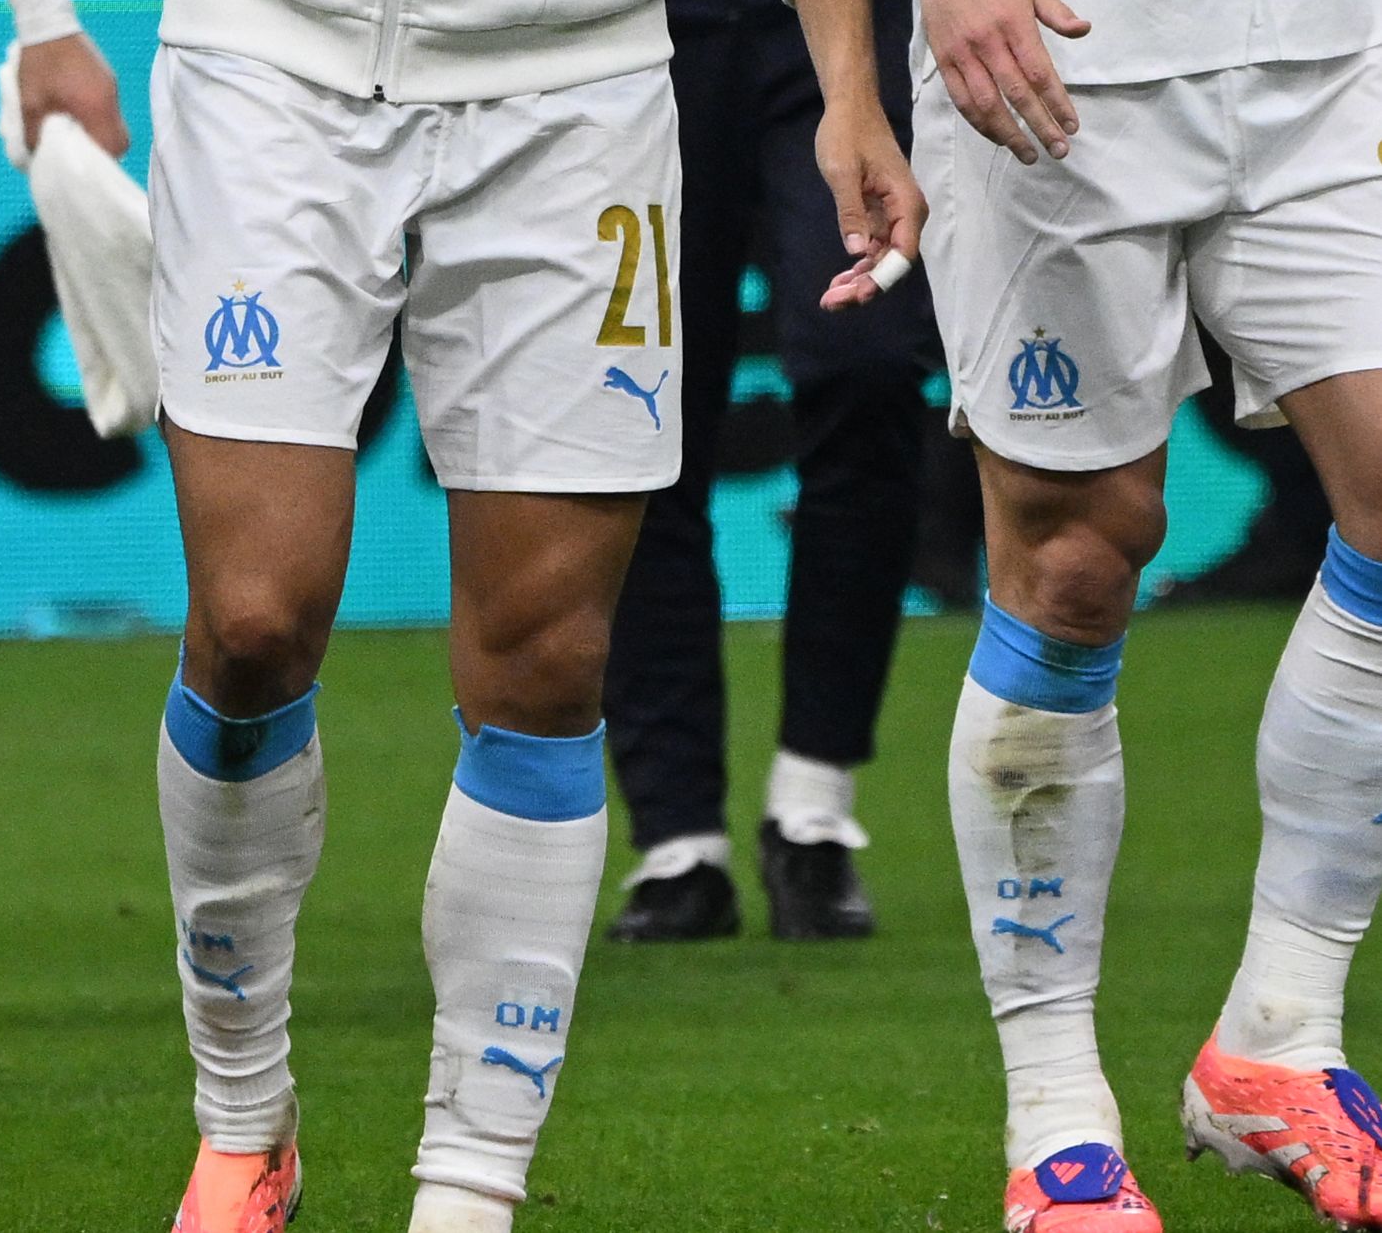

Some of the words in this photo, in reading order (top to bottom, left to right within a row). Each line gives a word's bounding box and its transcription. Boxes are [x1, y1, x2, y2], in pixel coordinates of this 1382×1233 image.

[595, 203, 672, 348] 21
[204, 374, 237, 384] DROIT
[241, 372, 257, 380] AU
[260, 371, 284, 380] BUT
[1009, 413, 1042, 421] DROIT
[1045, 412, 1059, 420] AU
[1062, 410, 1085, 419] BUT
[998, 877, 1065, 899] OM
[496, 1002, 561, 1033] OM
